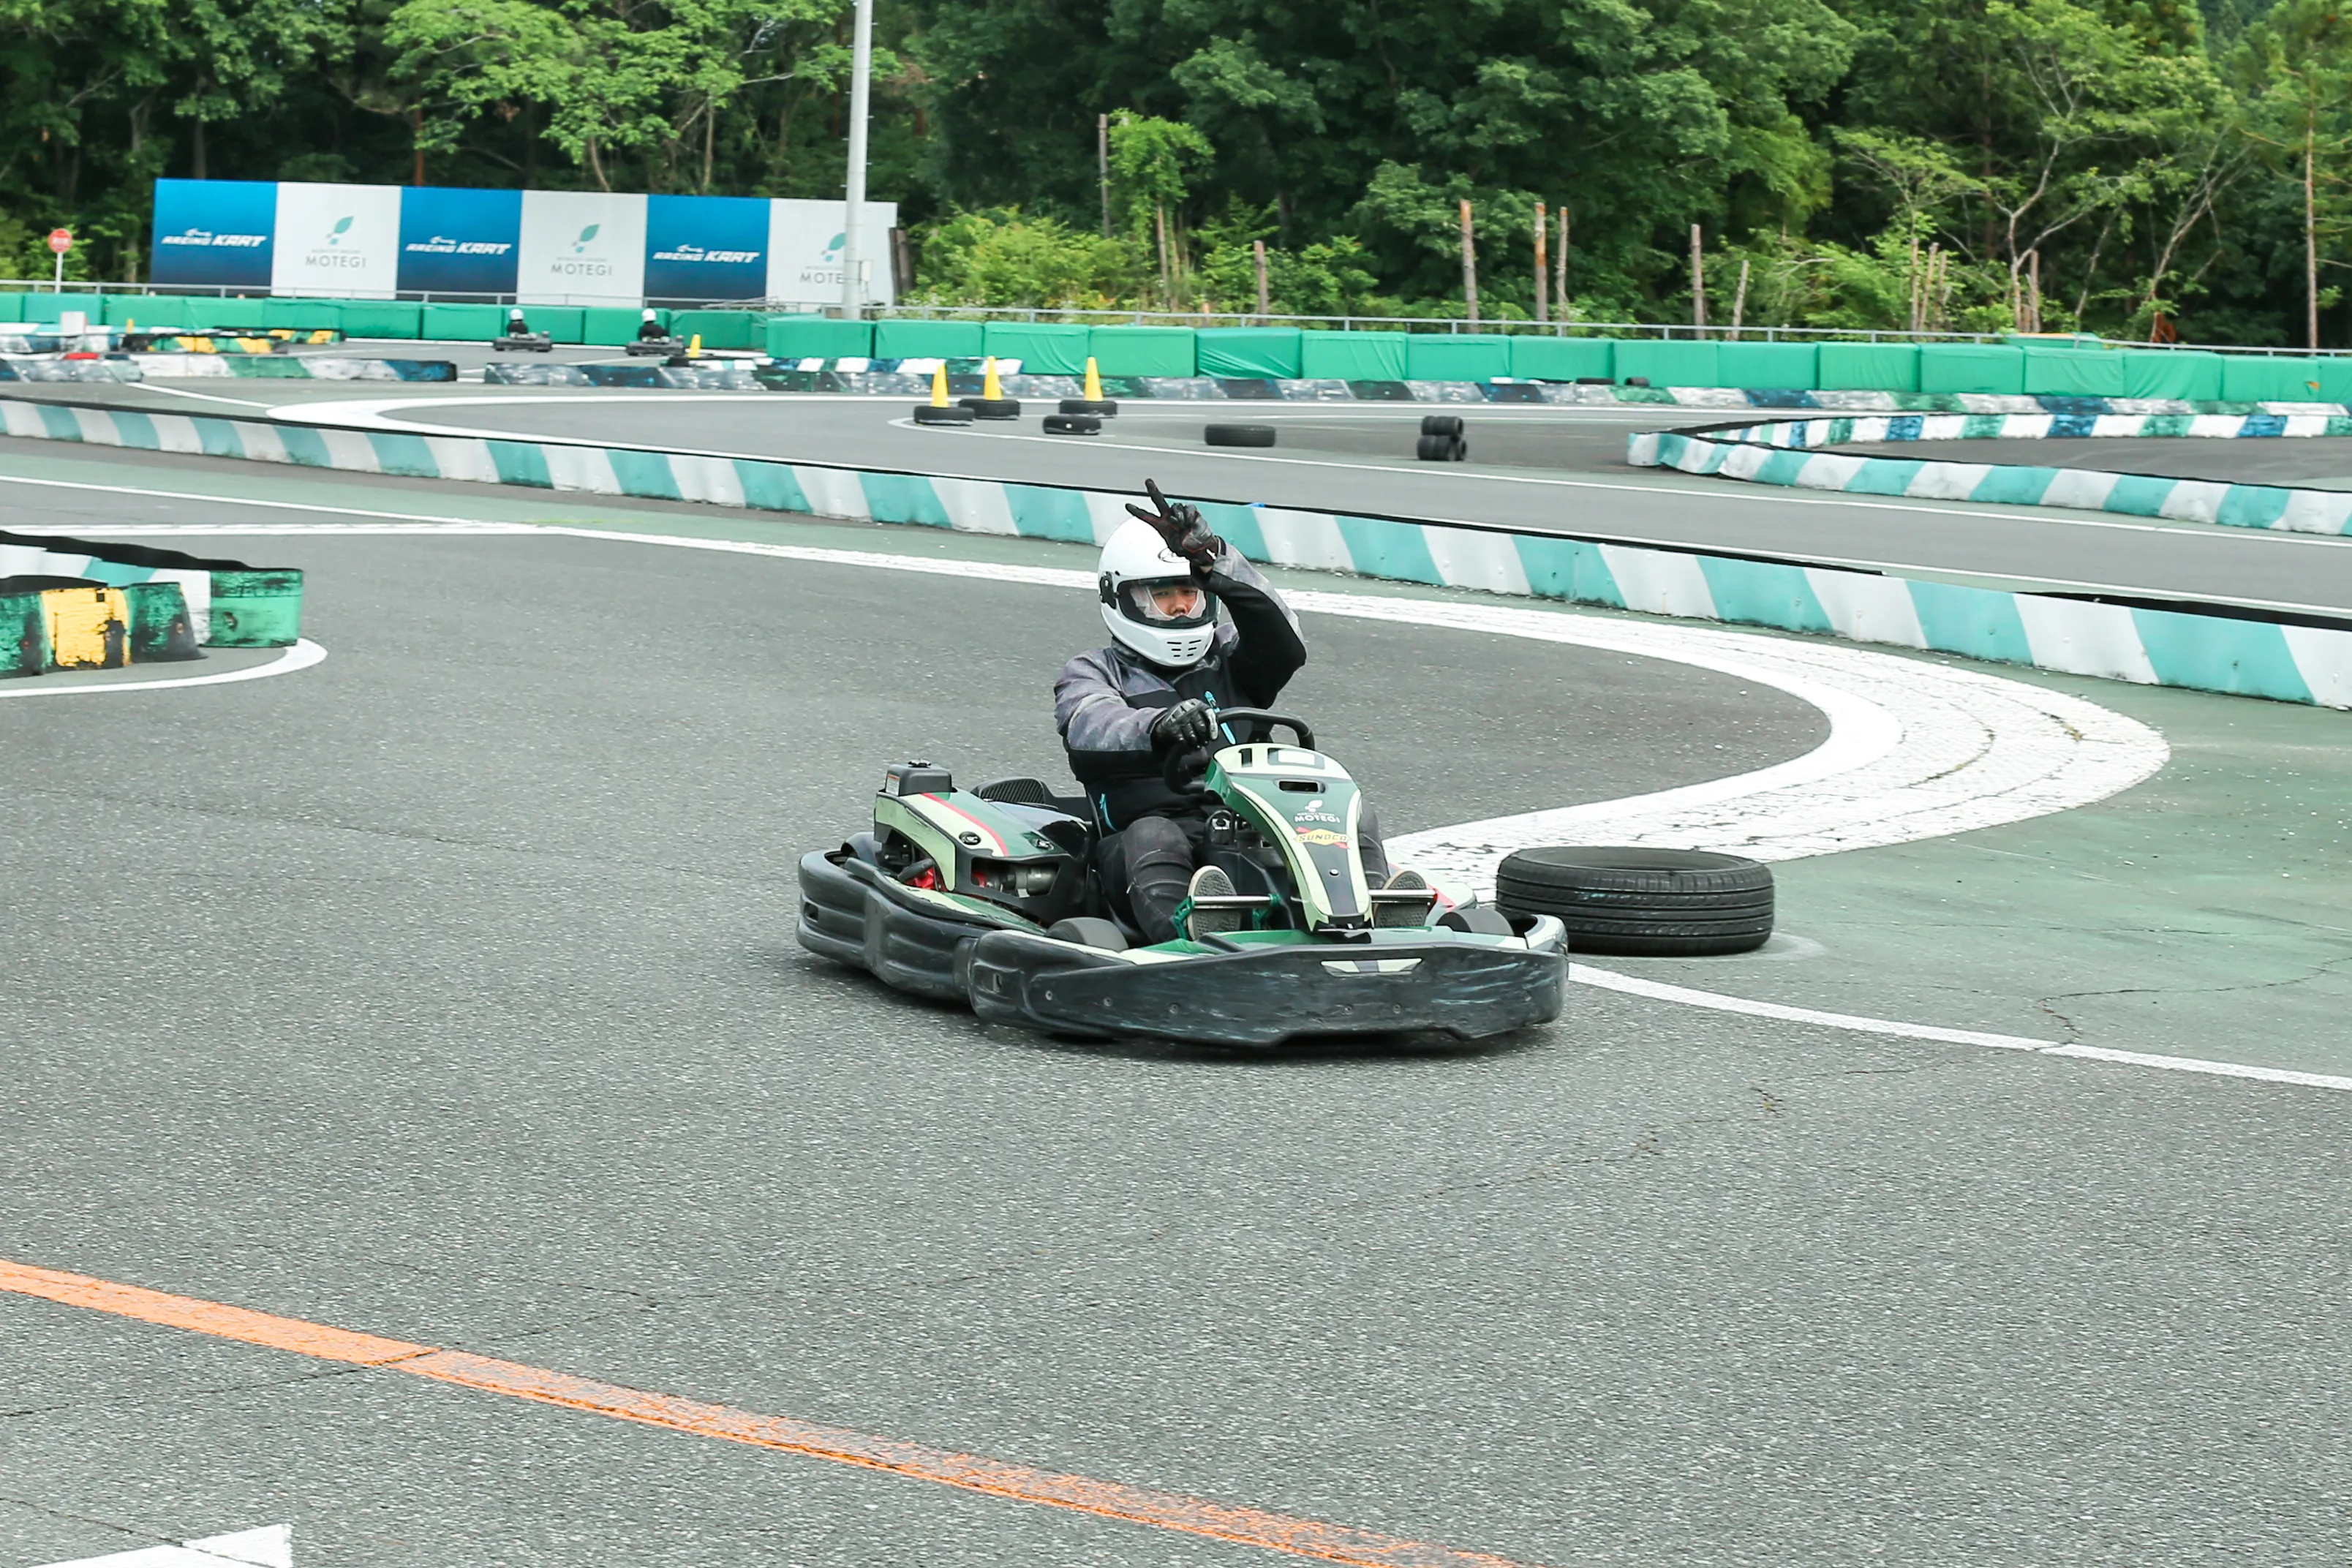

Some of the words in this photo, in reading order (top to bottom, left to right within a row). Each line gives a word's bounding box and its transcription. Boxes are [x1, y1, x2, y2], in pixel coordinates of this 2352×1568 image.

[161, 235, 211, 245] RACING
[211, 234, 267, 247] KART
[406, 244, 456, 253] RACING
[456, 242, 512, 255] KART
[305, 255, 366, 268] MOTEGI
[652, 252, 704, 261] RACING
[704, 250, 761, 263] KART
[550, 263, 613, 276] MOTEGI
[799, 271, 844, 284] MOTE
[1294, 815, 1341, 823] MOTEGI
